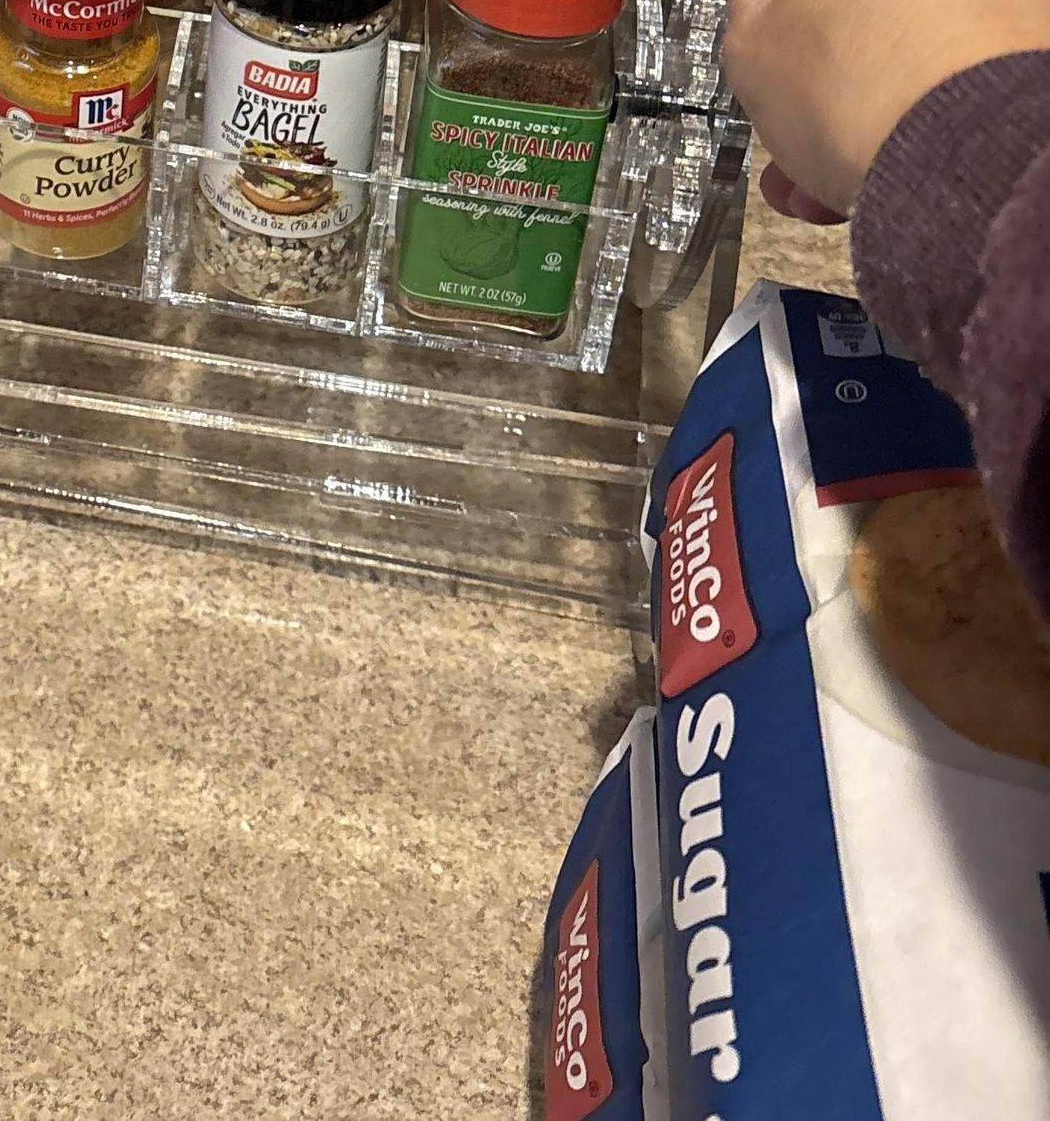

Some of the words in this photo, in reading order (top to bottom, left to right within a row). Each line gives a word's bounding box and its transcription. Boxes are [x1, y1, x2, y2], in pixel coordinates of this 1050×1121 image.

[32, 13, 52, 28] THE
[56, 21, 91, 31] TASTE
[97, 20, 118, 30] YOU
[249, 65, 312, 95] BADIA
[237, 85, 327, 114] EVERYTHING
[232, 98, 324, 146] BAGEL
[472, 115, 520, 130] TRADER
[525, 121, 561, 135] JOE'S
[430, 121, 500, 150] SPICY
[502, 133, 594, 162] ITALIAN
[55, 146, 130, 175] Curry
[487, 150, 527, 176] Style
[35, 160, 137, 198] Powder
[448, 170, 561, 202] SPRINKLE
[32, 211, 56, 222] Herbs
[251, 214, 267, 227] 2.8
[422, 193, 489, 220] seasoning
[494, 202, 527, 220] with
[524, 208, 579, 228] fennel
[439, 282, 458, 294] NET
[478, 287, 485, 298] 2
[486, 288, 499, 300] OZ
[500, 290, 526, 305] (57g)
[668, 518, 686, 627] FOODS
[672, 691, 741, 1083] Sugar
[554, 951, 565, 1068] FOODS
